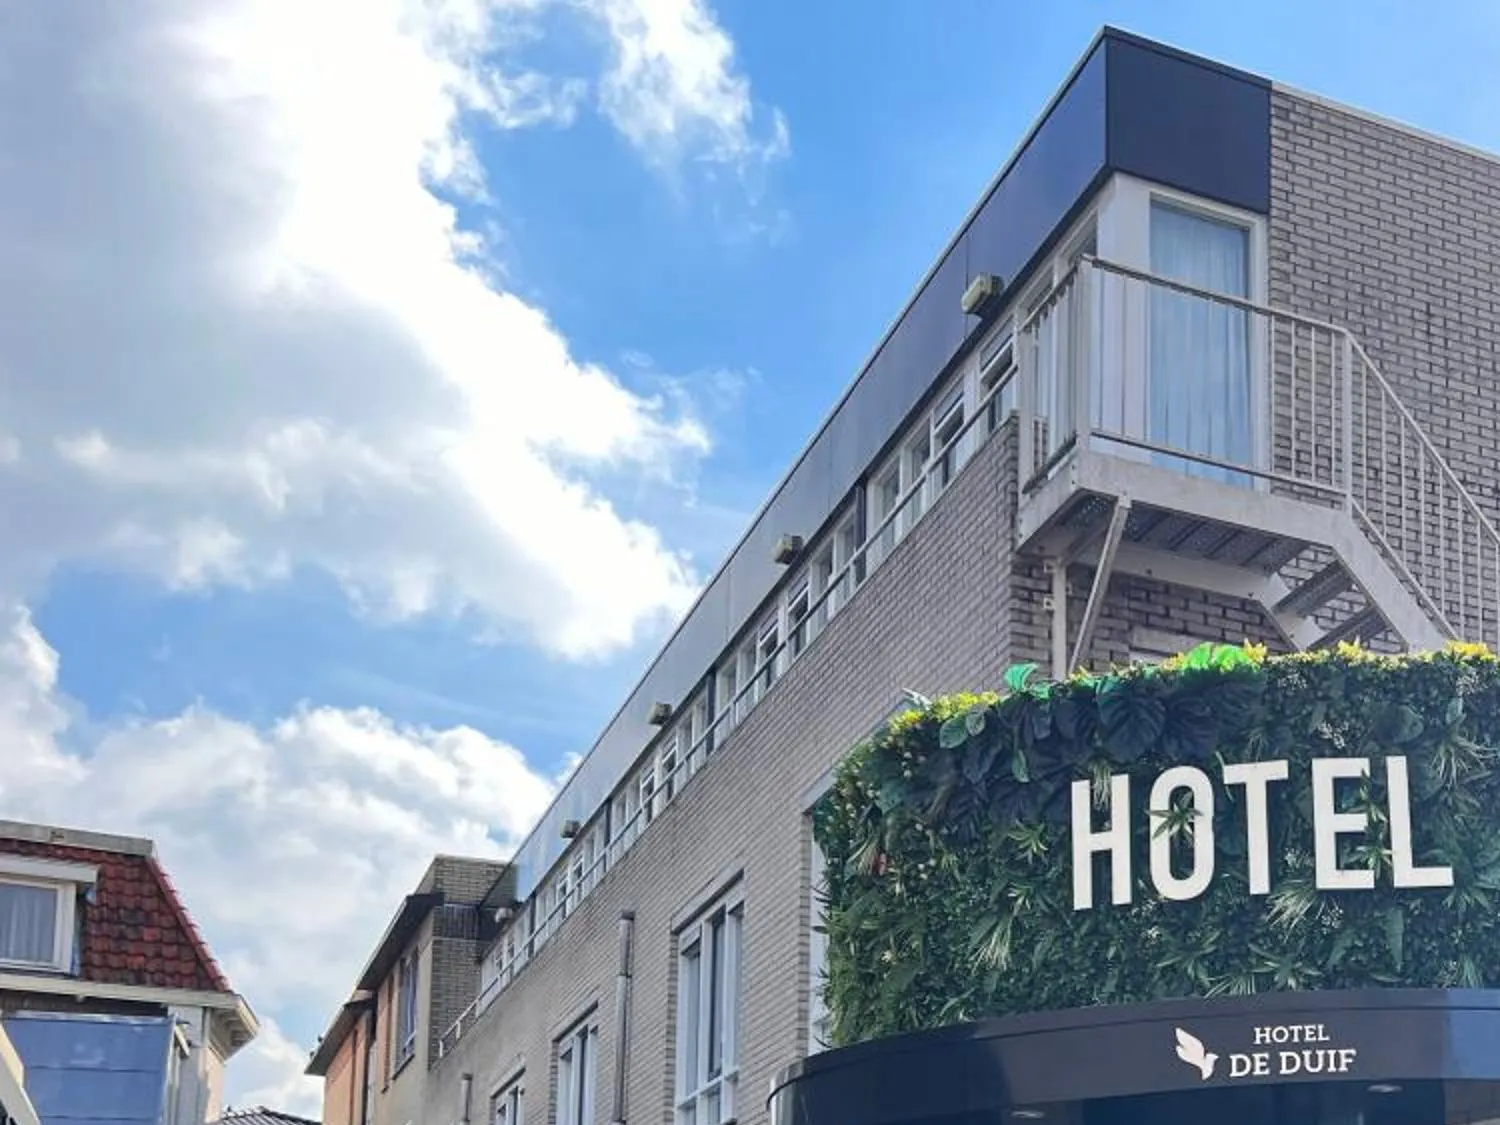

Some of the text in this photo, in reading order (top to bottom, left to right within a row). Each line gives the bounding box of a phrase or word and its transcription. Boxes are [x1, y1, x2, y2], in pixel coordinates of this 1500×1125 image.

[1071, 755, 1454, 910] HOTEL
[1253, 1023, 1331, 1045] HOTEL
[1229, 1048, 1358, 1078] DE DUIF
